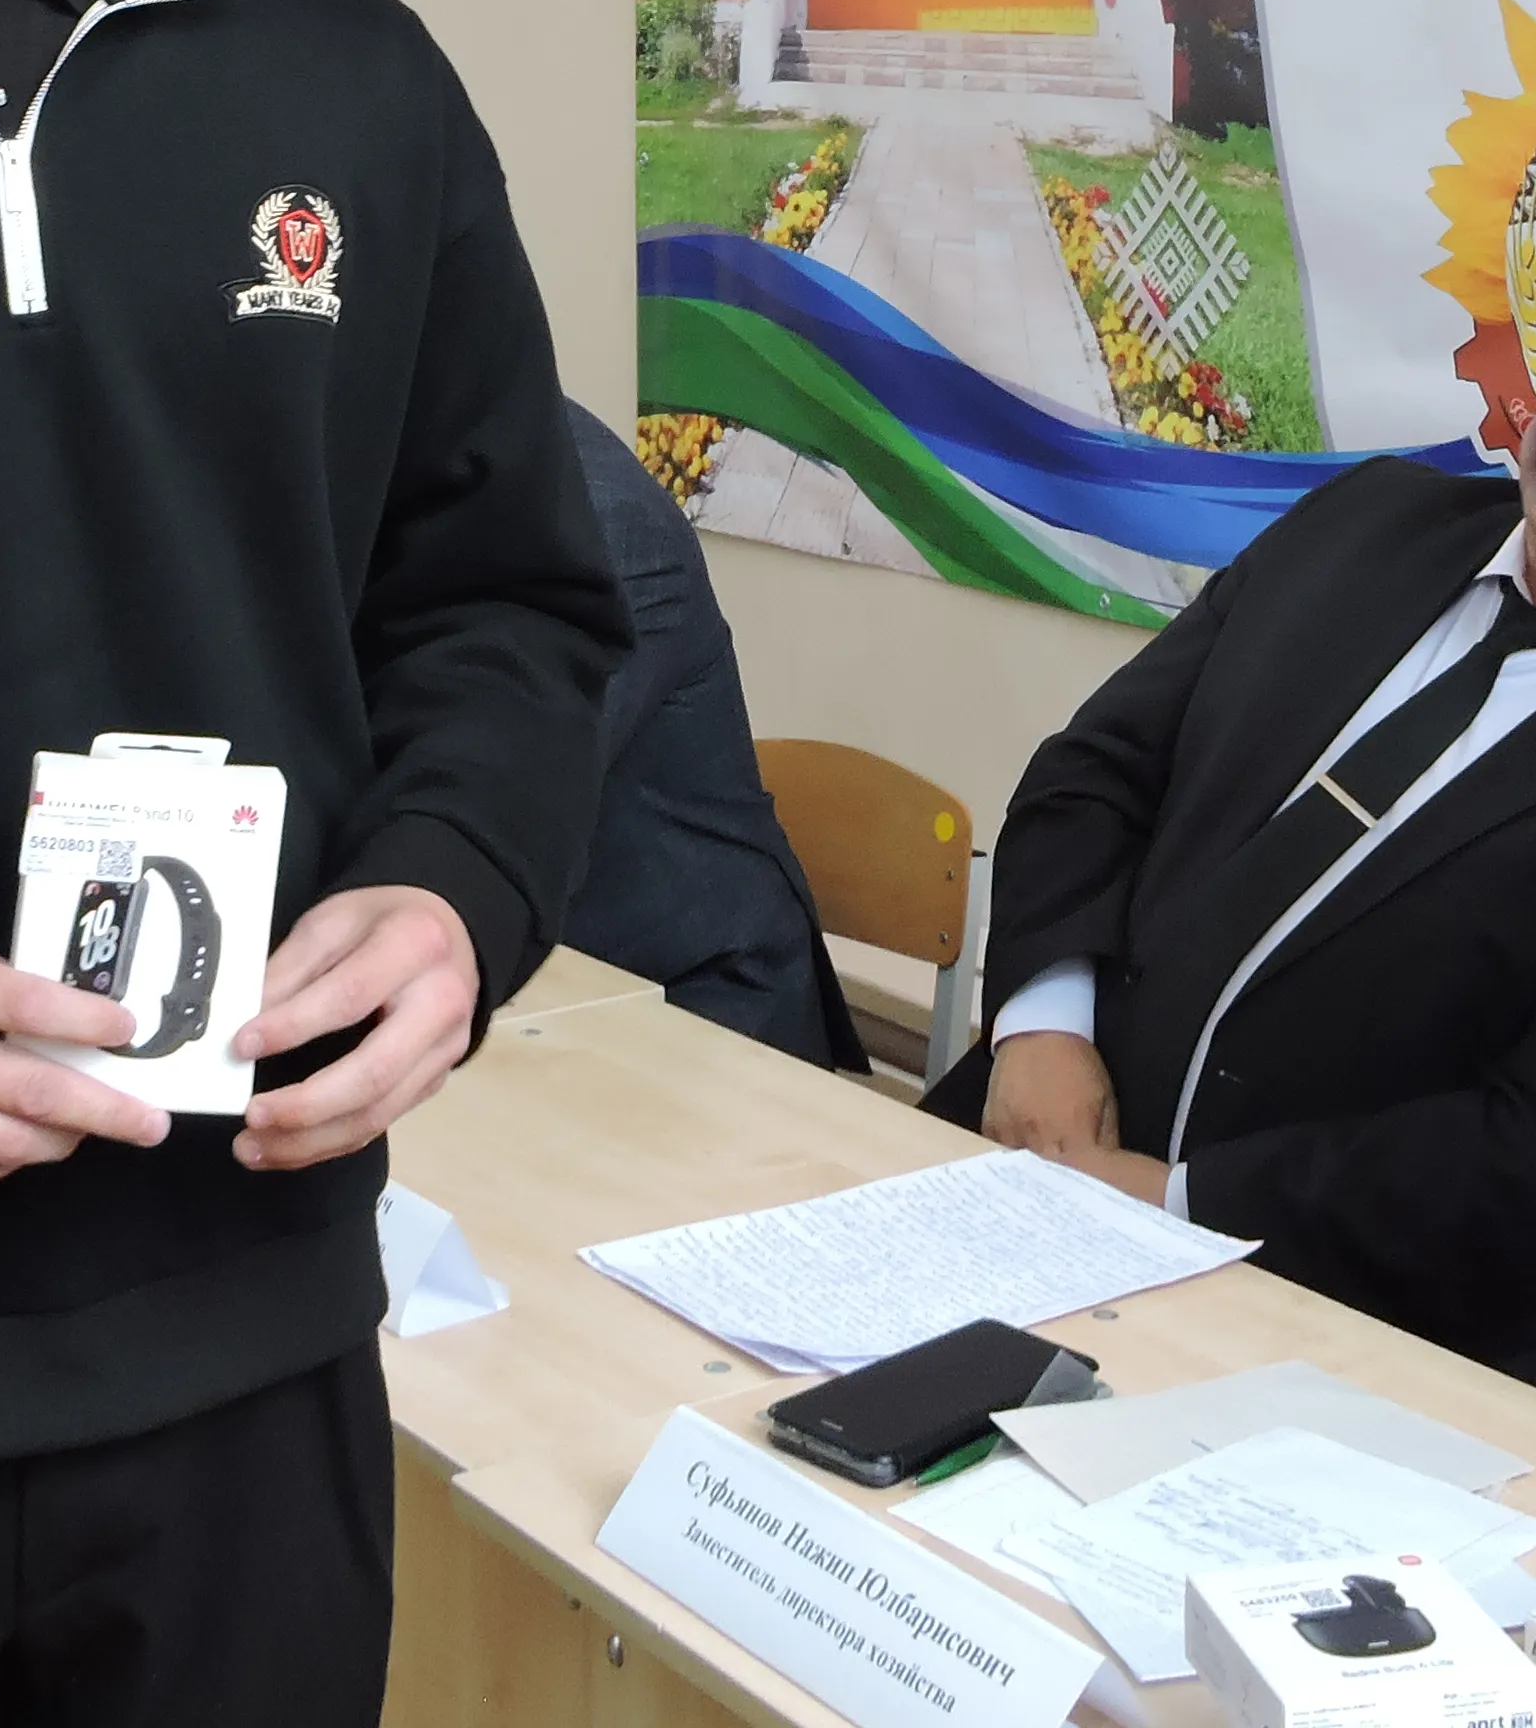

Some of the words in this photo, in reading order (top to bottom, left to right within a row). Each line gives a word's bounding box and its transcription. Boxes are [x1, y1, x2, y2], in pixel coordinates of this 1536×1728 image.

[78, 898, 117, 949] 10
[680, 1515, 777, 1595] Заместитель
[776, 1583, 866, 1654] директора
[864, 1643, 958, 1715] хозяйства
[685, 1459, 783, 1540] Суфьянов
[855, 1566, 1017, 1688] Юлбарисович
